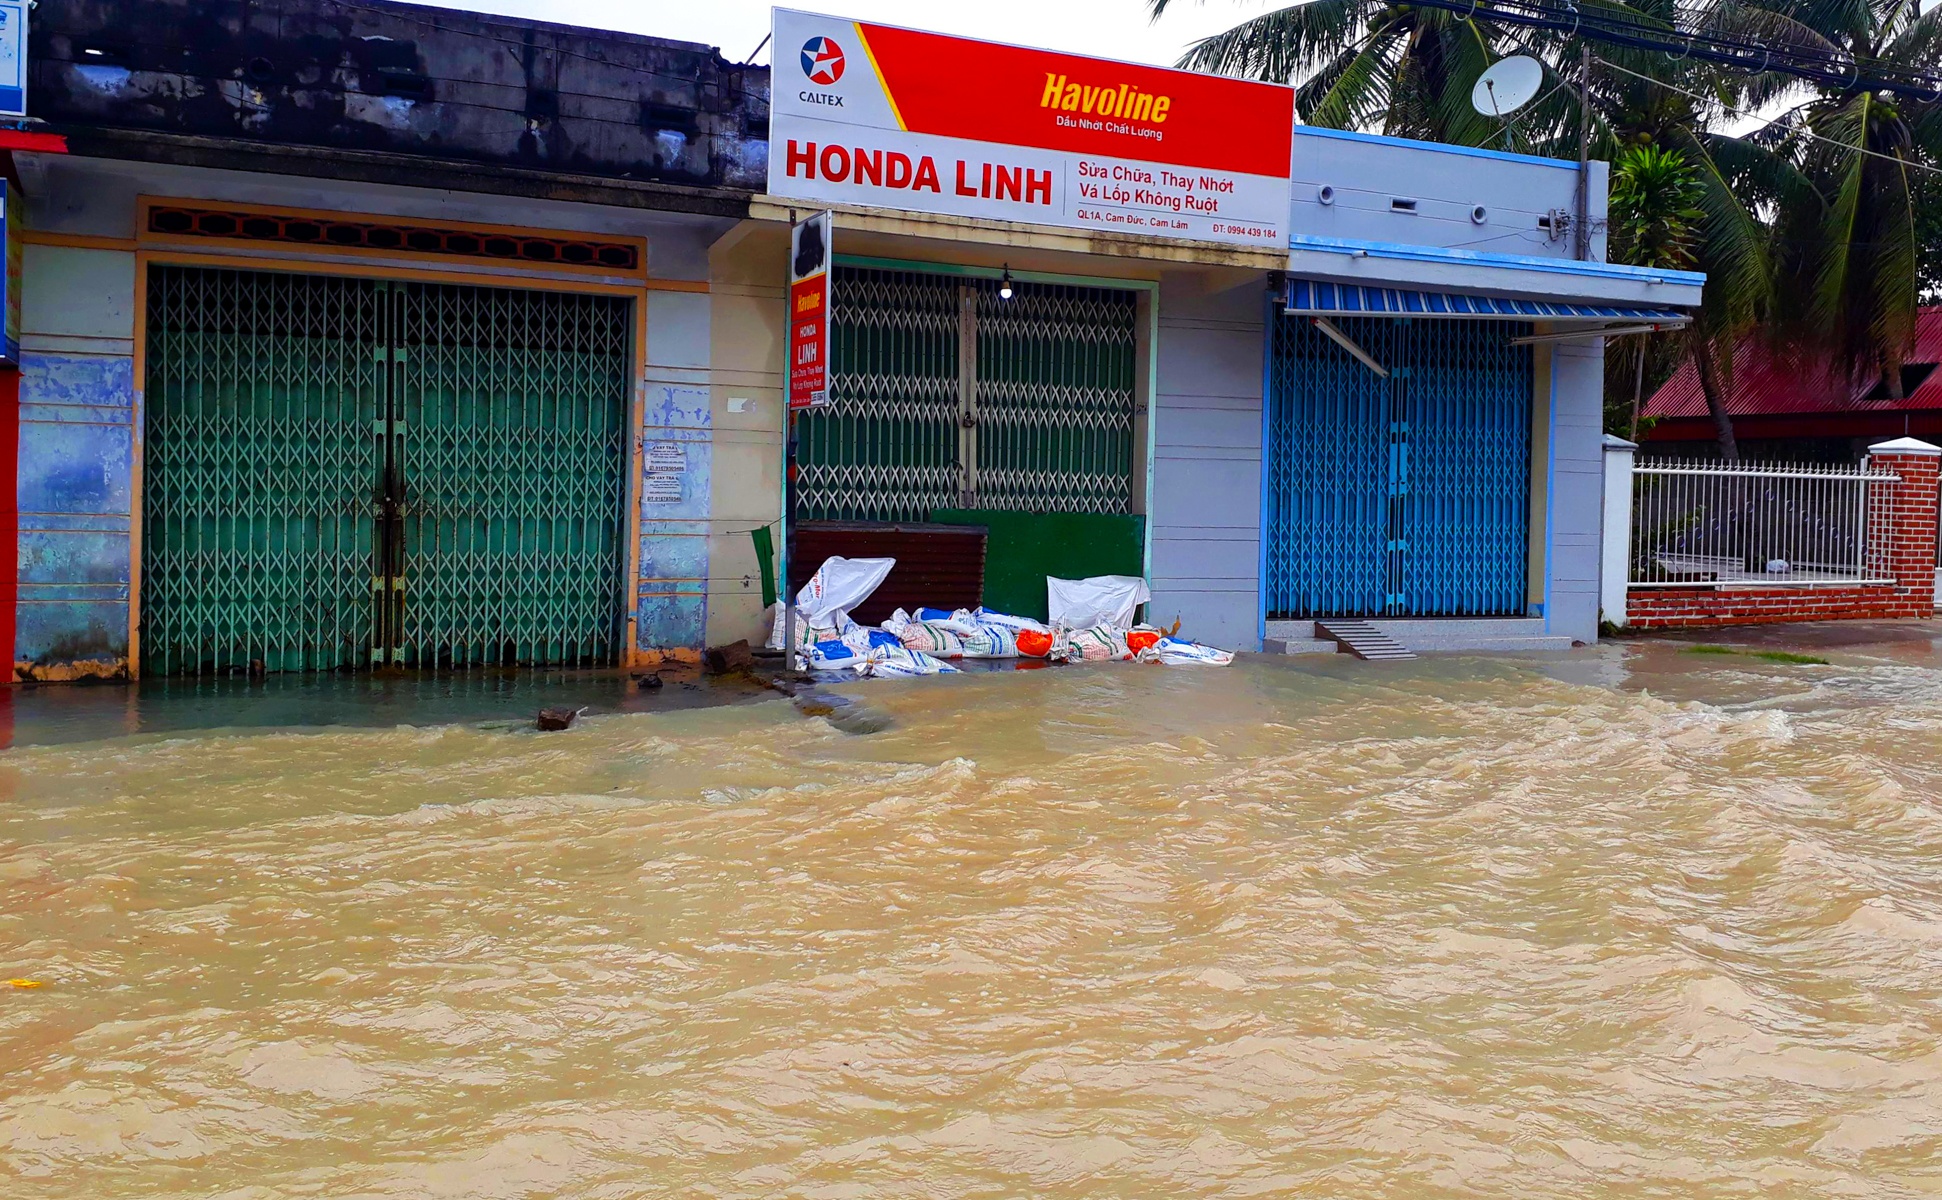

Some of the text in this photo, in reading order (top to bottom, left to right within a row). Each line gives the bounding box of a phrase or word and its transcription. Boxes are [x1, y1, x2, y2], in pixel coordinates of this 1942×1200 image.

[798, 91, 845, 108] CALTEX
[1040, 72, 1171, 123] Havoline
[1079, 118, 1103, 131] Nhớt
[1106, 122, 1129, 135] Chất
[1131, 126, 1163, 141] Lượng
[786, 139, 1052, 206] HONDA LINH
[1078, 161, 1234, 194] Sửa Chữa, Thay Nhớt
[1079, 182, 1218, 215] Vá Lốp Không Ruột
[1077, 209, 1188, 230] QL1A, Cam Đức, Cam Lâm
[1213, 224, 1276, 239] ĐT: 0994 439 184
[800, 323, 817, 339] HONDA
[798, 341, 817, 365] LINH
